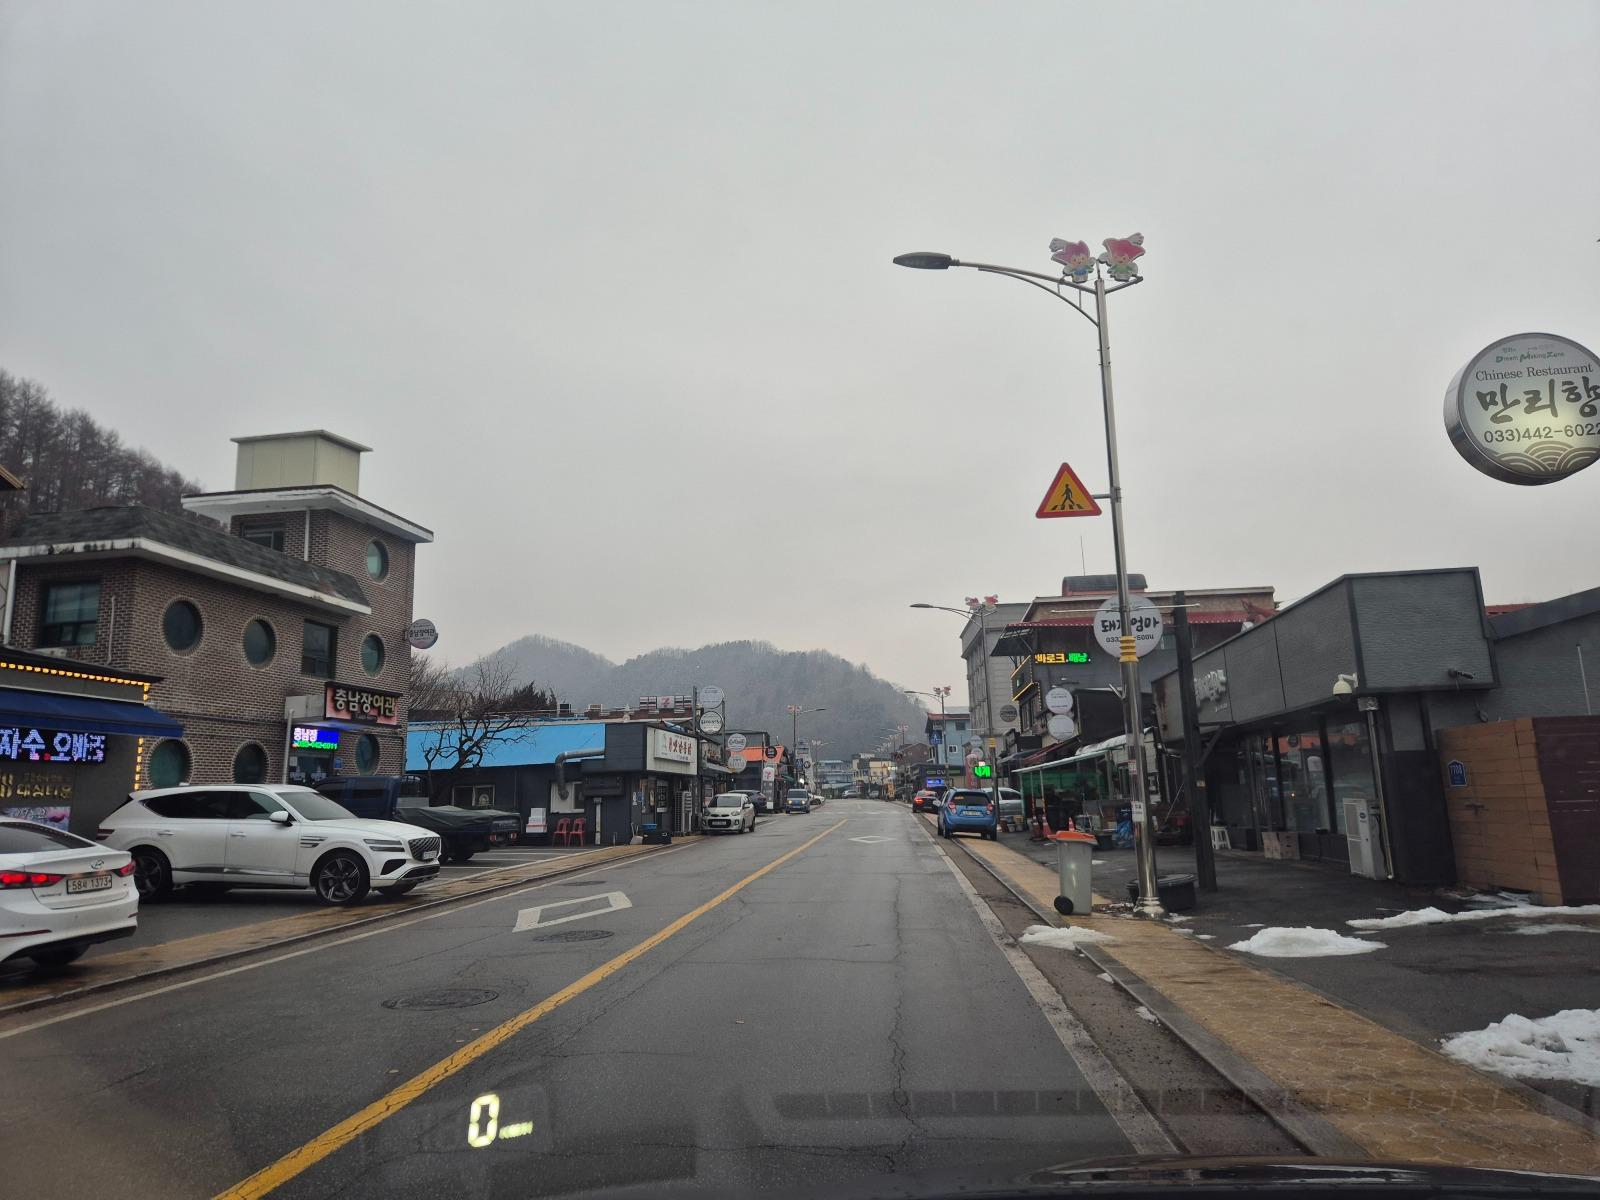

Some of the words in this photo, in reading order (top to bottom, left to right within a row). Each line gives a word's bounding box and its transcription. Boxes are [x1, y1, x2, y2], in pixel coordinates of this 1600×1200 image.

[1475, 369, 1524, 382] Chinese
[1526, 363, 1594, 378] Restaurant
[1475, 375, 1600, 425] 만리향
[335, 688, 395, 717] 충남장여관
[294, 727, 318, 742] 충남장
